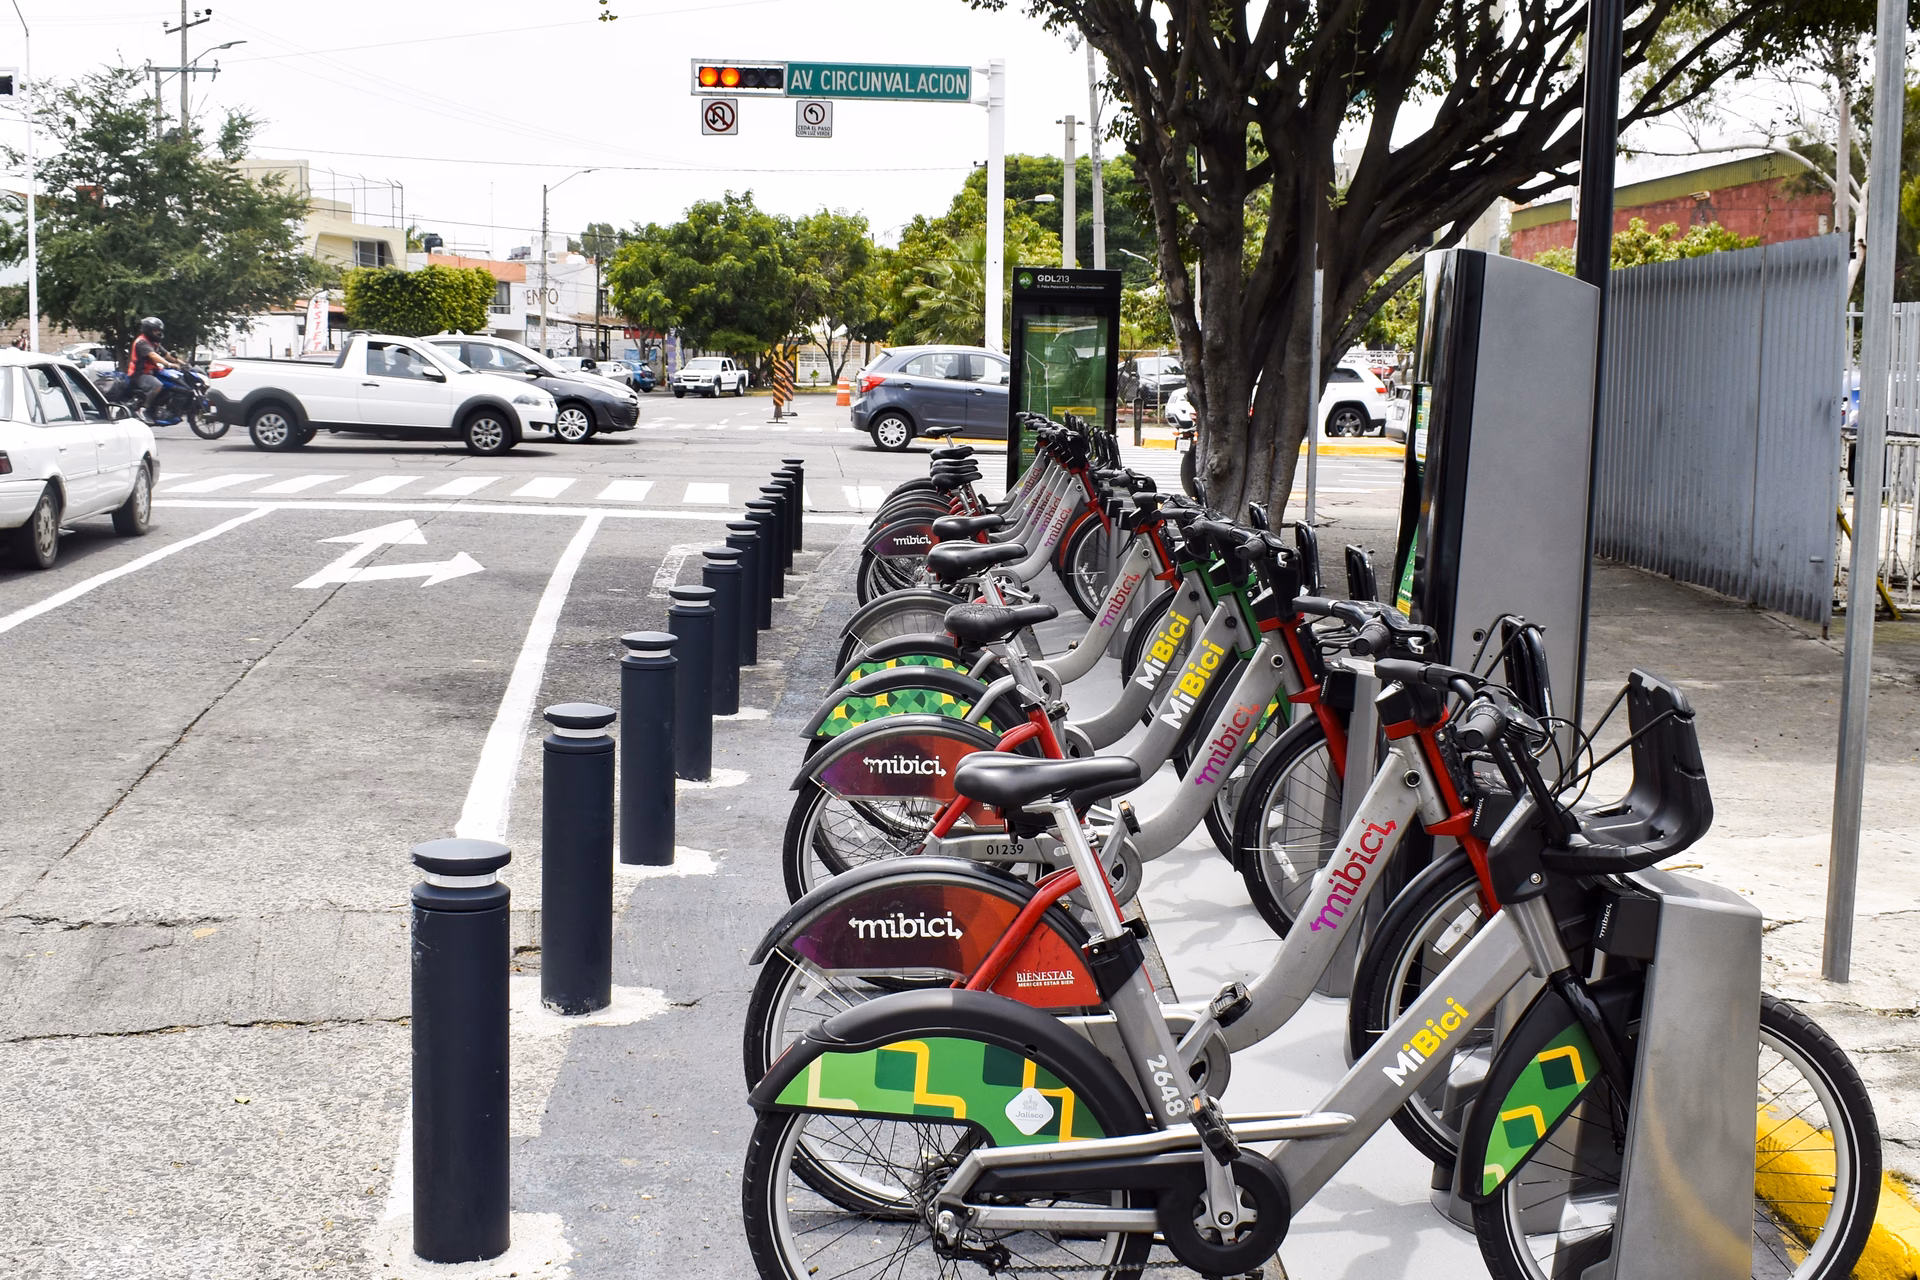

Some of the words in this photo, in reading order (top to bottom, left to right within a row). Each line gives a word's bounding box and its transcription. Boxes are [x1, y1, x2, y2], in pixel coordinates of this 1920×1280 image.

[820, 70, 967, 94] CIRCUNVALACION
[1037, 274, 1070, 283] GDL213
[1020, 467, 1043, 499] mibici
[1038, 496, 1063, 534] mibici
[1044, 508, 1073, 547] mibici
[893, 535, 932, 546] mibici
[1099, 572, 1141, 628] mibici
[1135, 610, 1191, 691] MiBici
[1159, 639, 1225, 730] MiBici
[1320, 675, 1329, 698] mibici
[1194, 703, 1261, 786] mibici
[862, 755, 947, 778] mibici
[1473, 797, 1485, 828] mibici
[986, 844, 1024, 855] 01239
[1309, 818, 1397, 932] mibici
[848, 911, 963, 940] mibici
[1599, 903, 1613, 939] mibici
[1016, 970, 1075, 982] BIENESTAR
[1382, 997, 1469, 1087] MiBici
[1146, 1053, 1185, 1117] 2648
[1015, 1111, 1044, 1119] Jalisco
